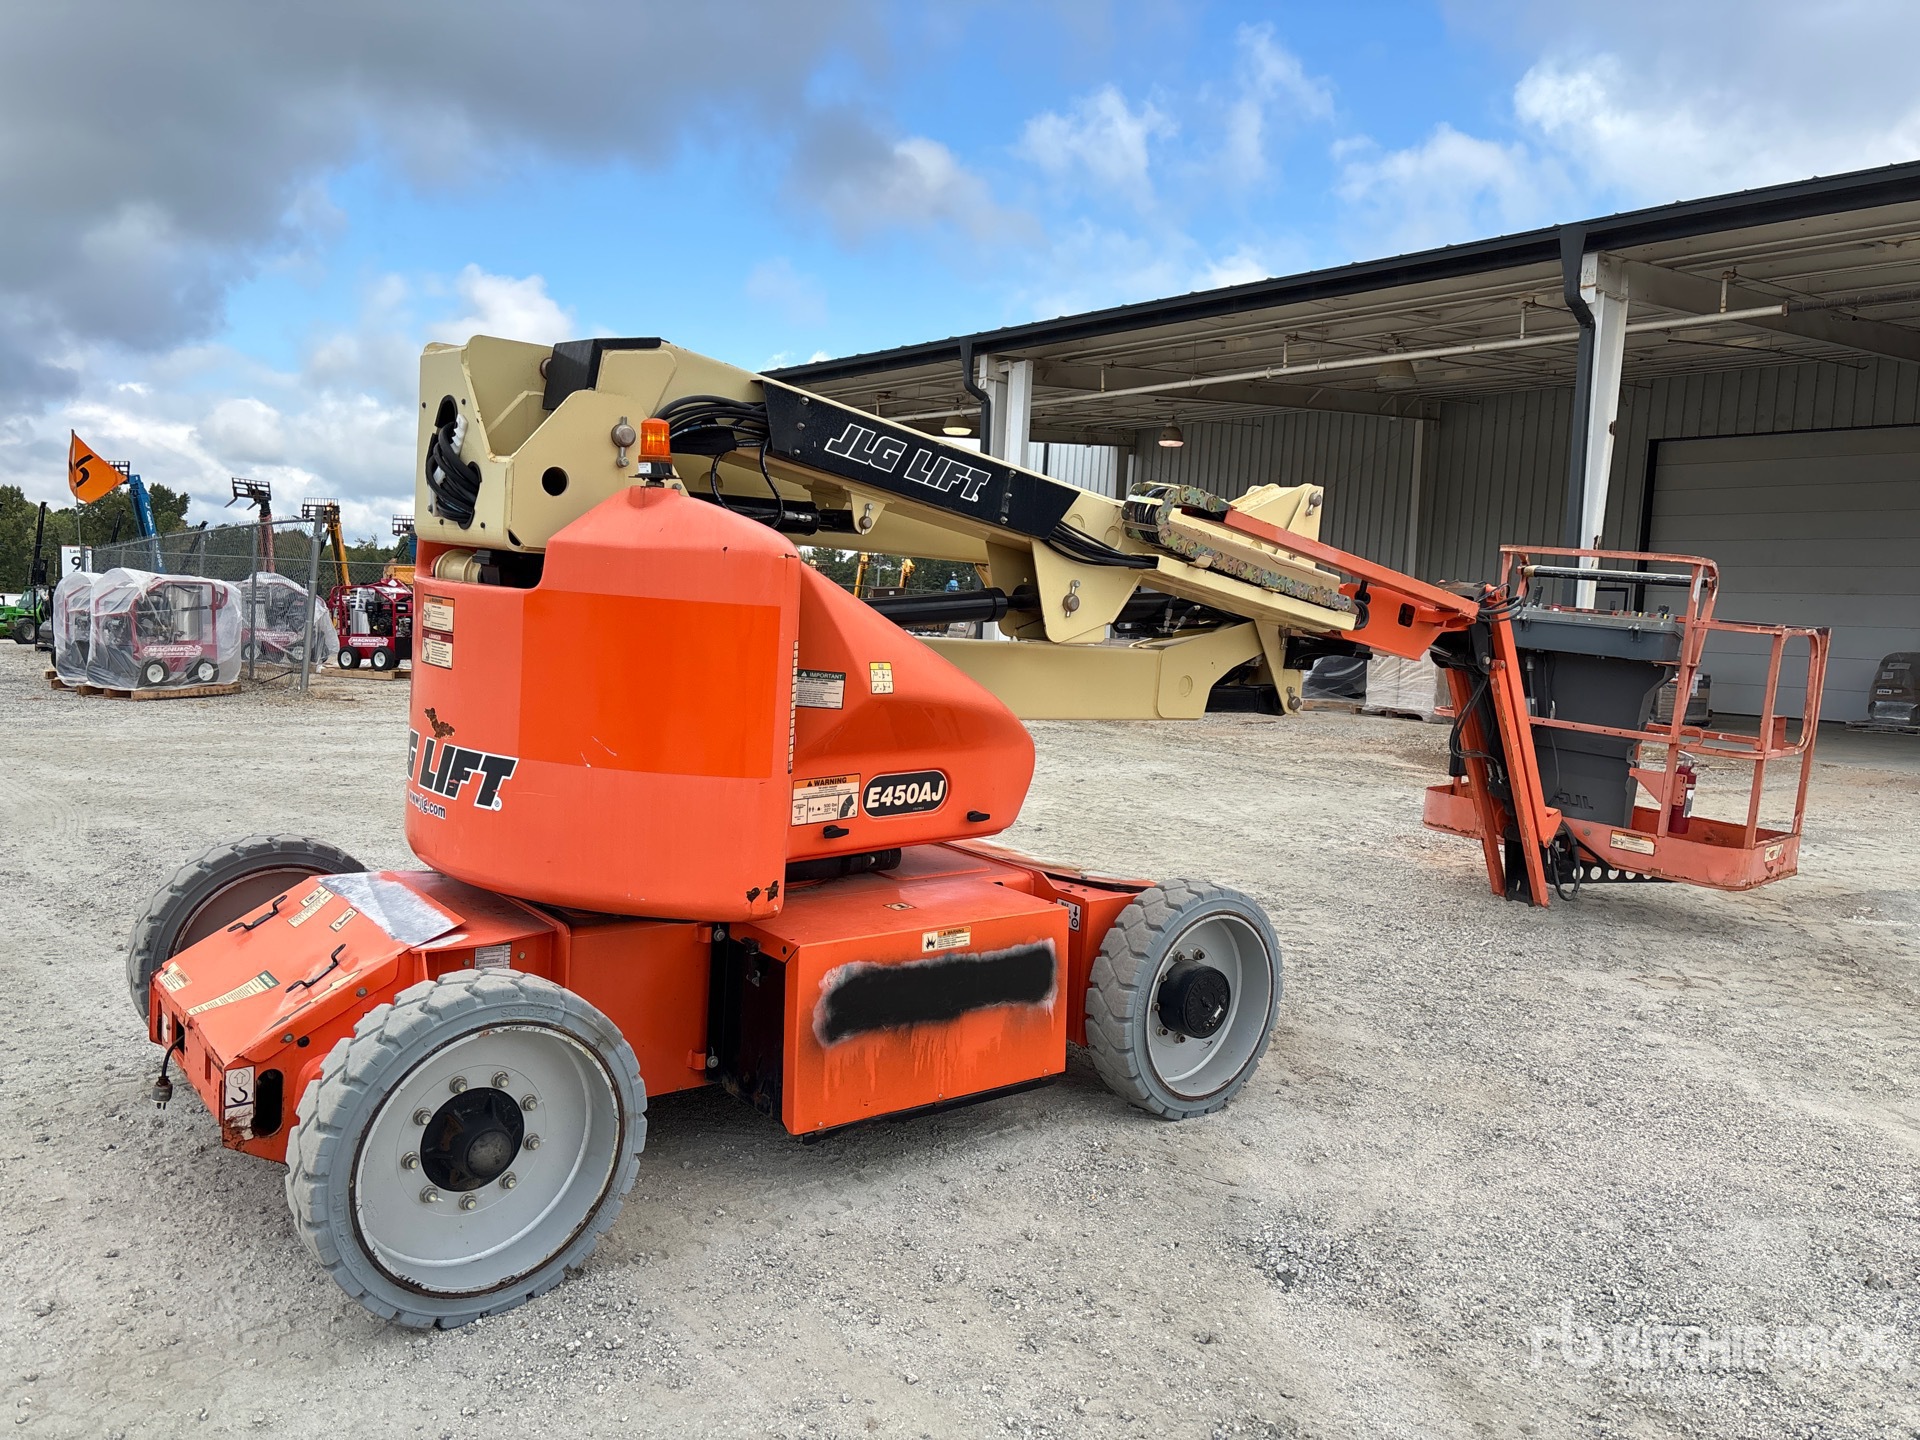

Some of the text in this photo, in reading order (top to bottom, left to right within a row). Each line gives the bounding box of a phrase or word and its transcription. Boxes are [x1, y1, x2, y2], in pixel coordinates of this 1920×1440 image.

[824, 423, 992, 502] JLG LIFT
[809, 672, 843, 680] IMPORTANT
[813, 777, 847, 787] WARNING
[866, 780, 945, 809] E450AJ
